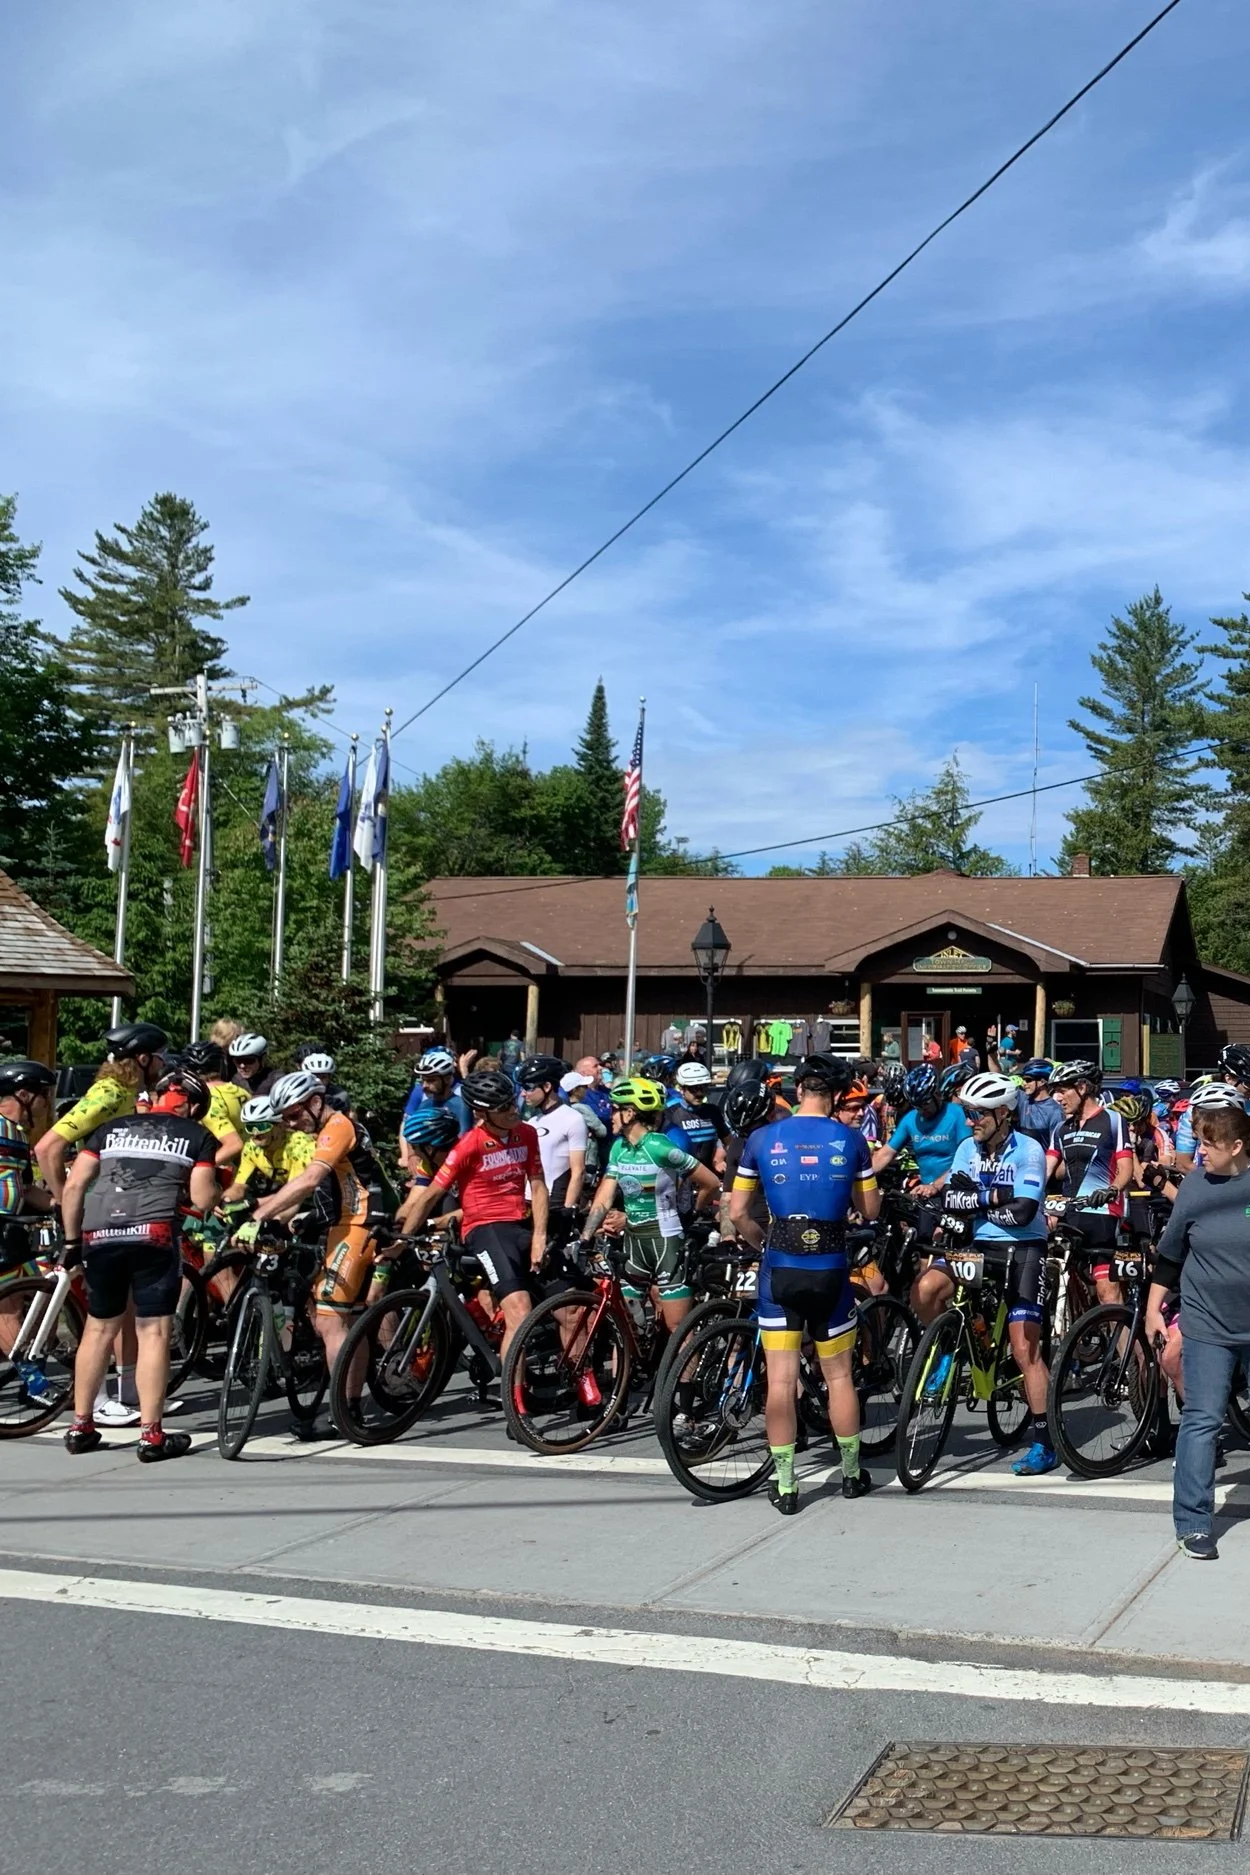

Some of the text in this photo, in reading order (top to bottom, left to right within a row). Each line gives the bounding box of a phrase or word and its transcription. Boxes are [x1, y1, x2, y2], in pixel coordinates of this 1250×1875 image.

[105, 1134, 190, 1158] Battenkill
[944, 1190, 980, 1210] FinKraft
[1044, 1200, 1066, 1212] 06
[950, 1260, 976, 1281] 110
[1114, 1259, 1138, 1277] 76
